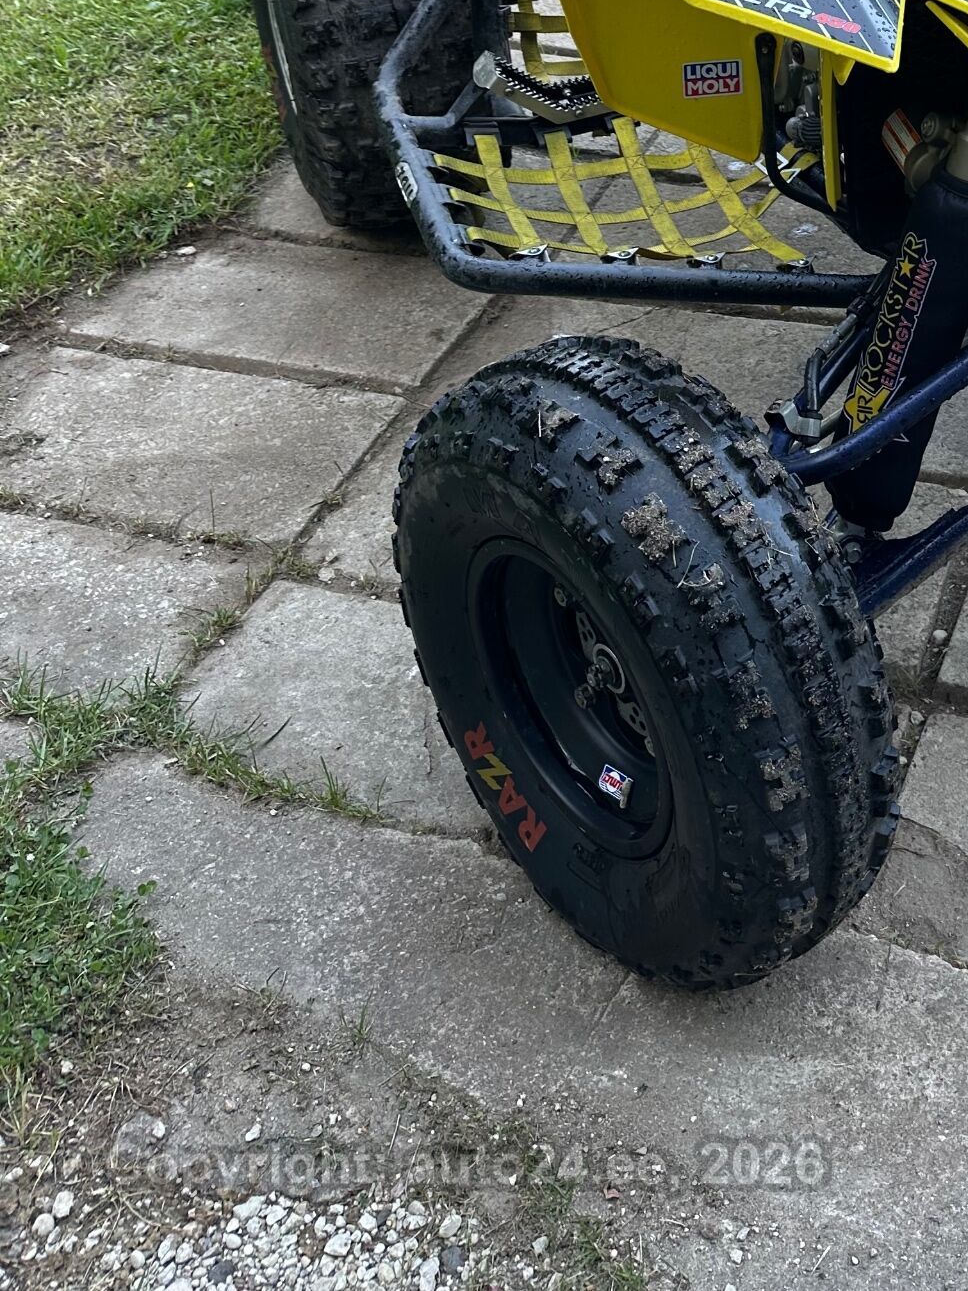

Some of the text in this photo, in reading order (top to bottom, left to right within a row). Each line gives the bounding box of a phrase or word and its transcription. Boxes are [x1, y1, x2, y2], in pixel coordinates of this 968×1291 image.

[684, 63, 738, 79] LIQUI
[686, 79, 741, 96] MOLY
[880, 259, 934, 388] ENERGY DRINK
[464, 721, 547, 853] RAZR
